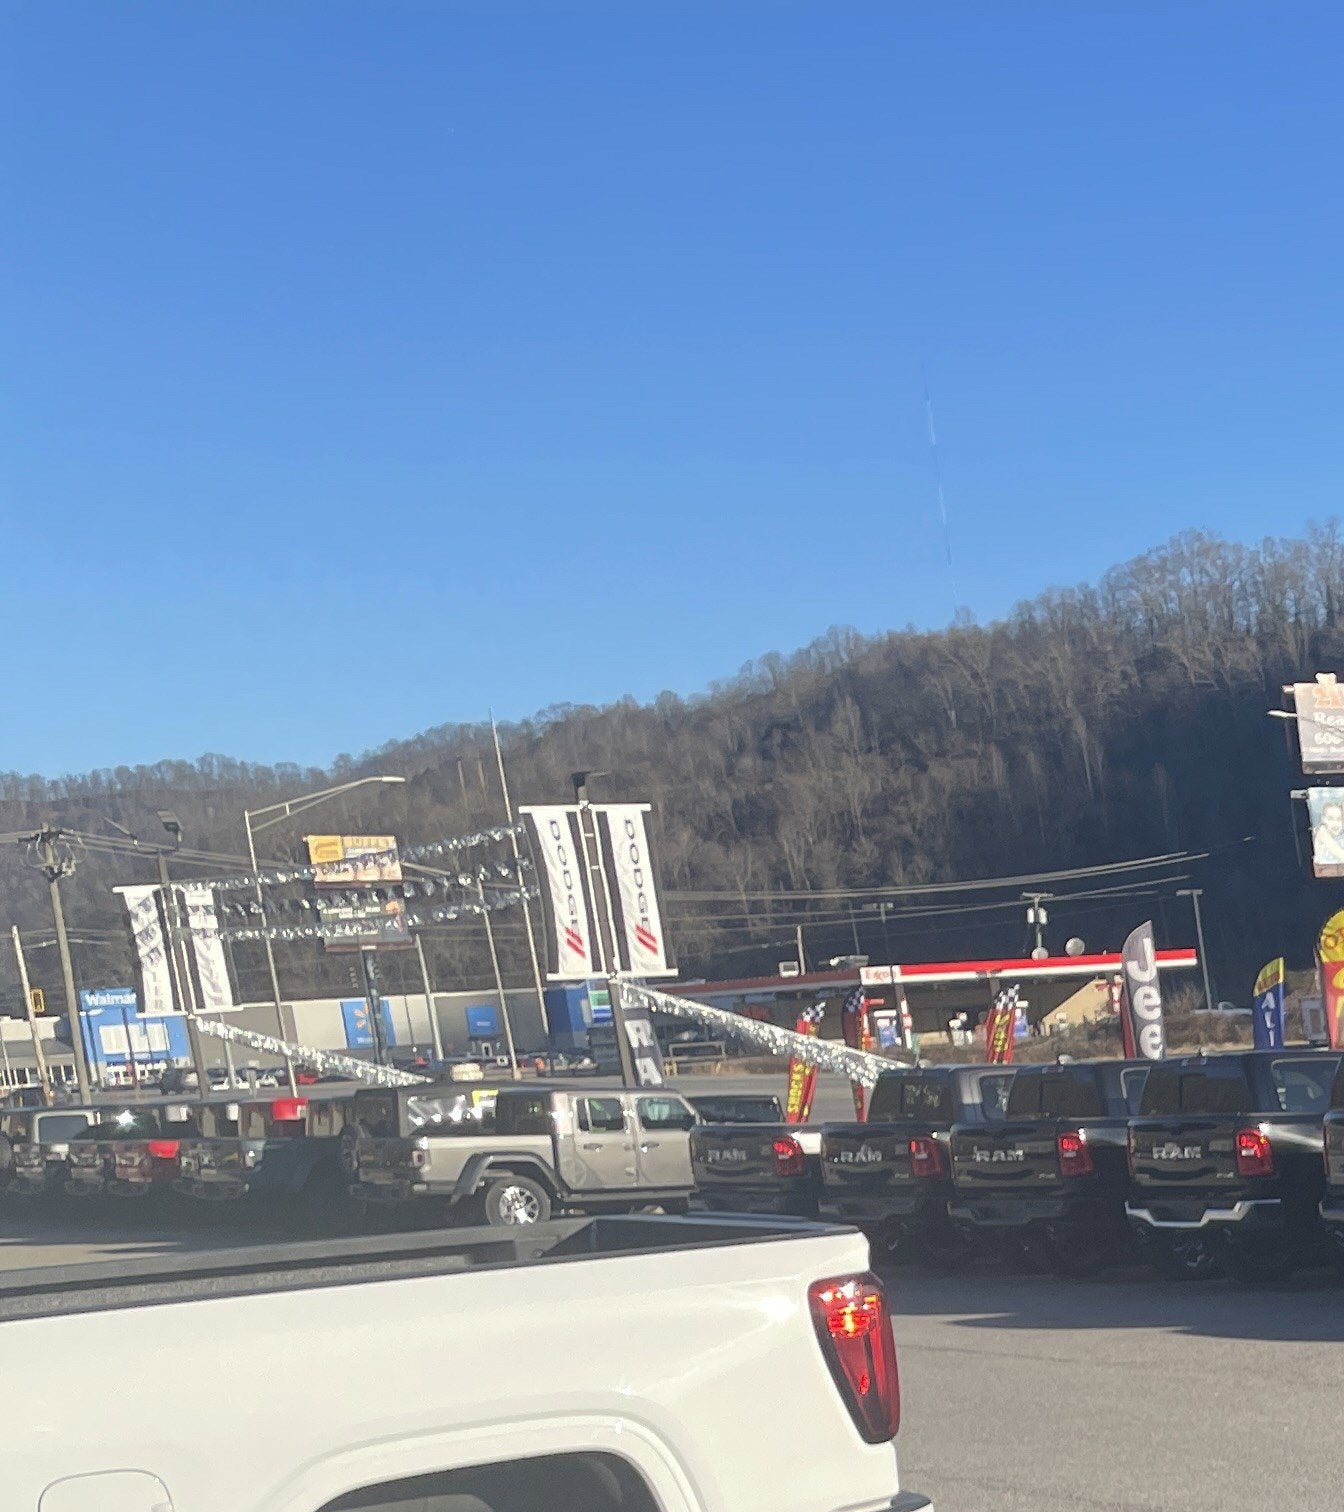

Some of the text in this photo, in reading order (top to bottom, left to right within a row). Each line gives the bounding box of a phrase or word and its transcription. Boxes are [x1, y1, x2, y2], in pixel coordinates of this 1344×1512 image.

[550, 819, 579, 926] DODGE
[624, 818, 650, 926] DODGE
[1127, 936, 1163, 1060] Jee
[974, 1146, 1025, 1163] RAM
[1152, 1142, 1202, 1160] RAM
